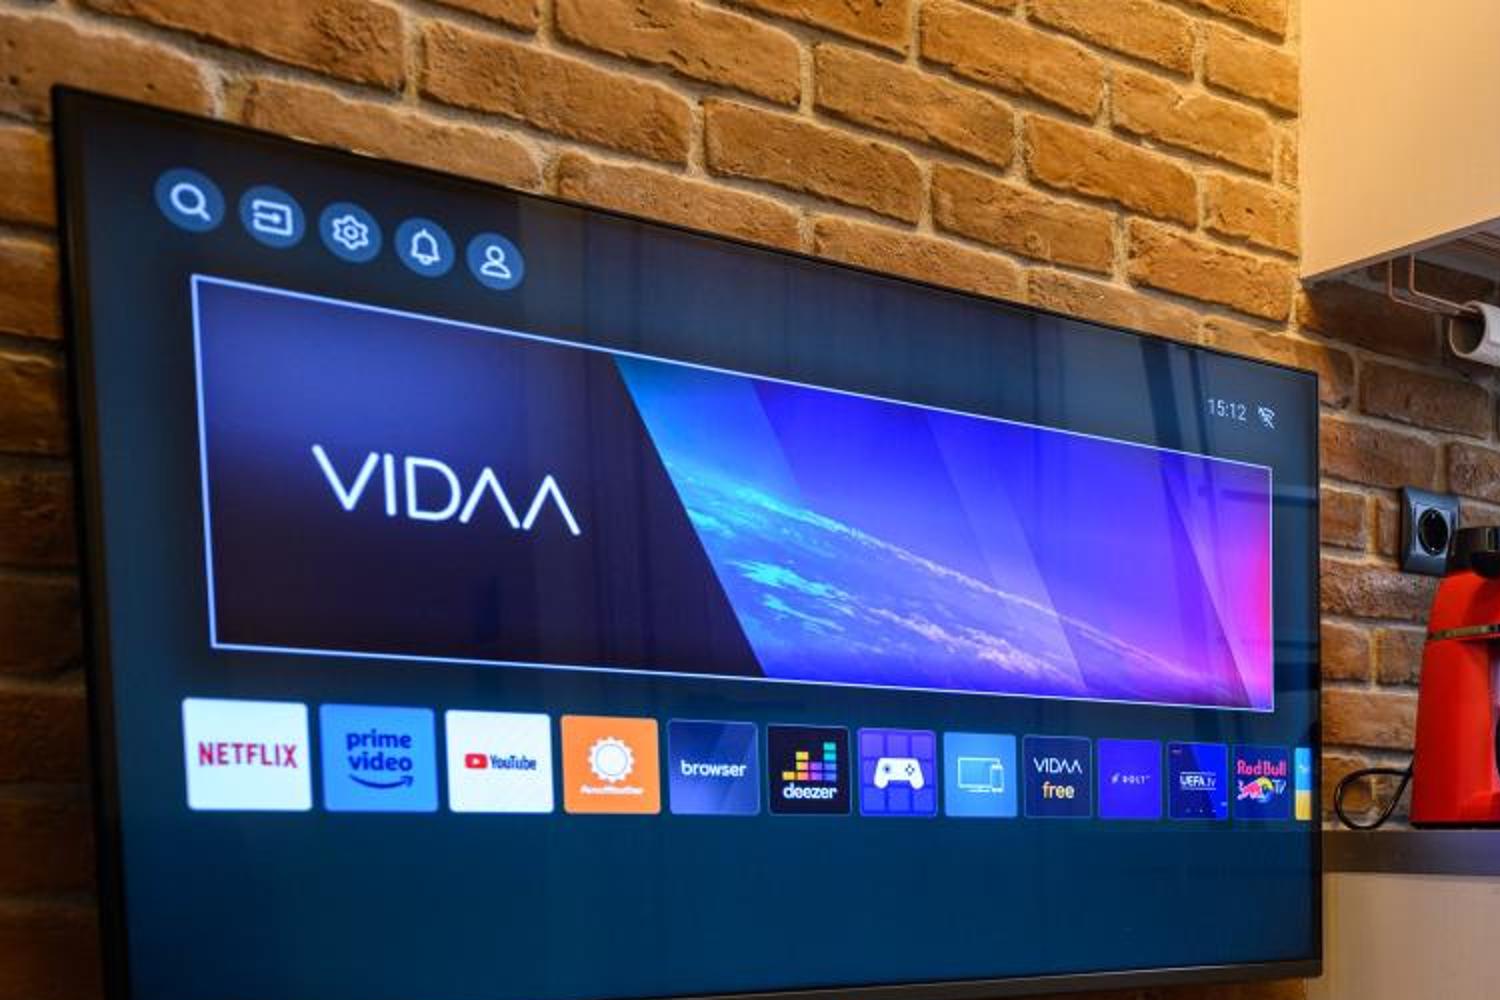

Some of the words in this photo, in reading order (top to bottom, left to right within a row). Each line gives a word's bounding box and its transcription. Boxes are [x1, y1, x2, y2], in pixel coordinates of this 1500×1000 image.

[1207, 399, 1247, 422] 15:12
[311, 444, 581, 536] VIDAA
[346, 728, 412, 752] prime
[198, 740, 298, 769] NETFLIX
[348, 751, 413, 772] video
[490, 754, 537, 771] YouTube
[680, 759, 747, 777] browser
[1033, 757, 1083, 774] VIDAA
[1236, 759, 1261, 775] Red
[1263, 760, 1287, 777] Bull
[782, 782, 838, 800] deezer
[1042, 780, 1076, 799] free
